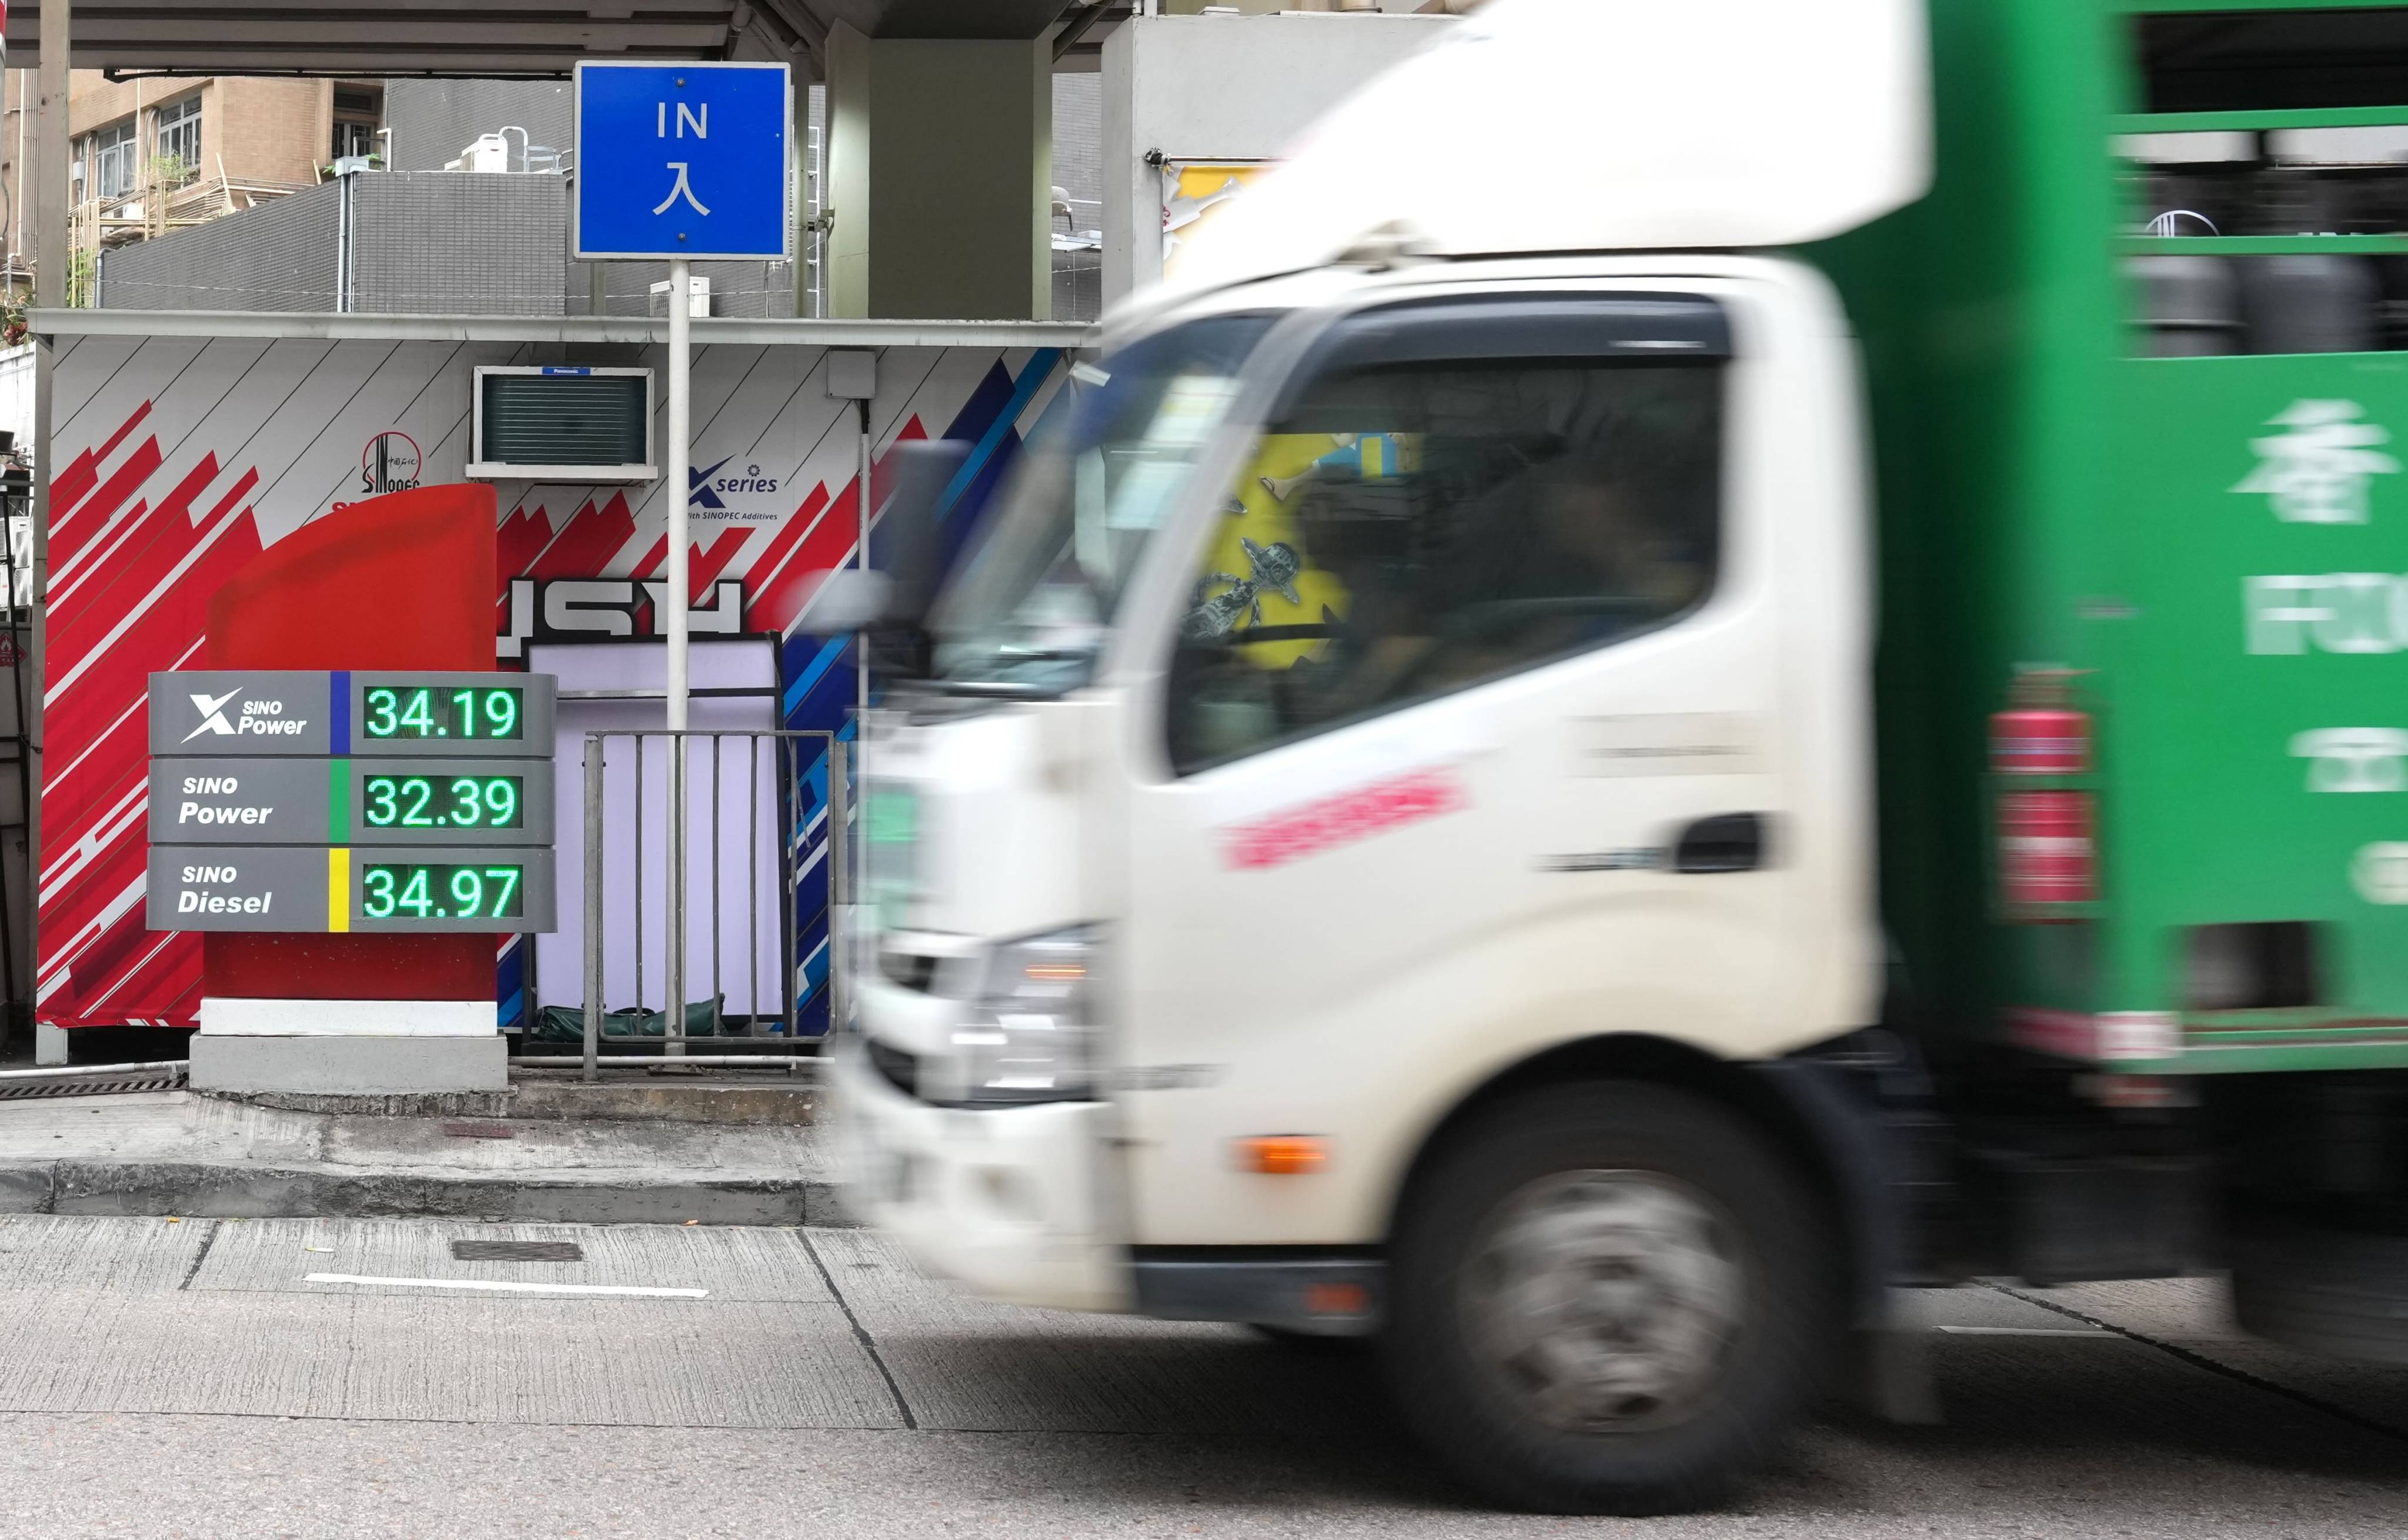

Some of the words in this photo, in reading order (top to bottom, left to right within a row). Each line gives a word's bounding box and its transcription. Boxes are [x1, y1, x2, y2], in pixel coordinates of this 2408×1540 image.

[658, 102, 707, 139] IN
[652, 162, 711, 216] 入
[716, 463, 778, 493] series
[702, 512, 740, 520] SINOPEC
[741, 512, 778, 520] Additives
[242, 700, 283, 716] SINO
[368, 690, 516, 737] 34.19
[237, 716, 308, 736] Power
[182, 777, 238, 795] SINO
[178, 801, 273, 825] Power
[367, 779, 516, 826] 32.39
[181, 866, 238, 884] SINO
[178, 891, 272, 914] Diesel
[364, 869, 519, 917] 34.97
